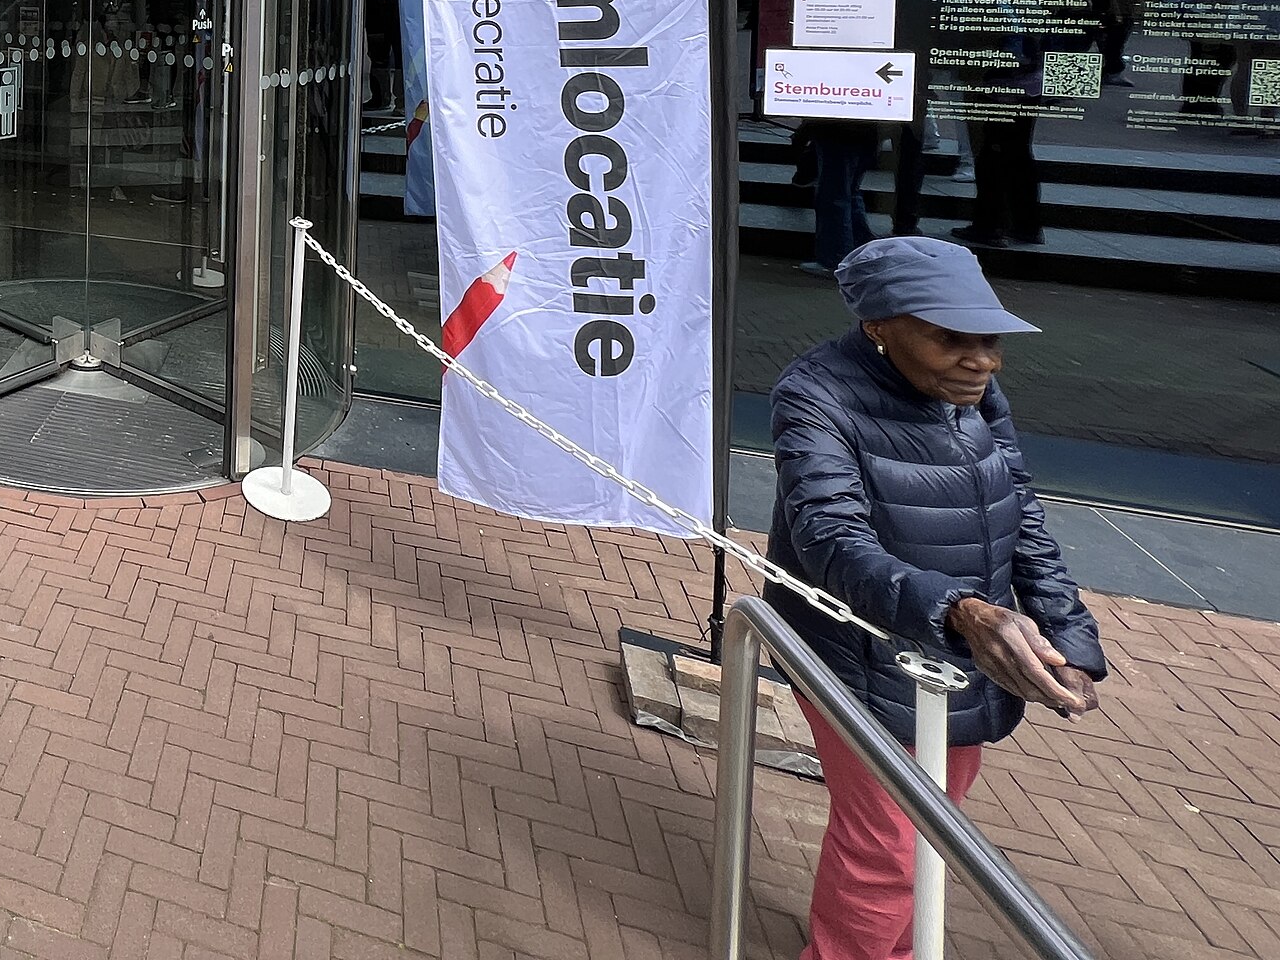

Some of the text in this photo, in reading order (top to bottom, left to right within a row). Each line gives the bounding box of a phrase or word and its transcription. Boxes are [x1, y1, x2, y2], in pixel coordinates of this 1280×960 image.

[1145, 1, 1179, 9] Tickets
[1196, 2, 1212, 10] the
[1161, 12, 1181, 20] only
[192, 18, 212, 30] Push
[1159, 20, 1186, 28] ticket
[1250, 32, 1264, 40] for
[930, 48, 1016, 60] Openingstijden,
[1132, 54, 1220, 66] Opening hours,
[929, 57, 965, 66] tickets
[982, 59, 1020, 69] prijzen
[1132, 64, 1232, 76] tickets and prices
[774, 81, 882, 98] Stembureau
[928, 84, 1025, 95] annefrank.org/tickets
